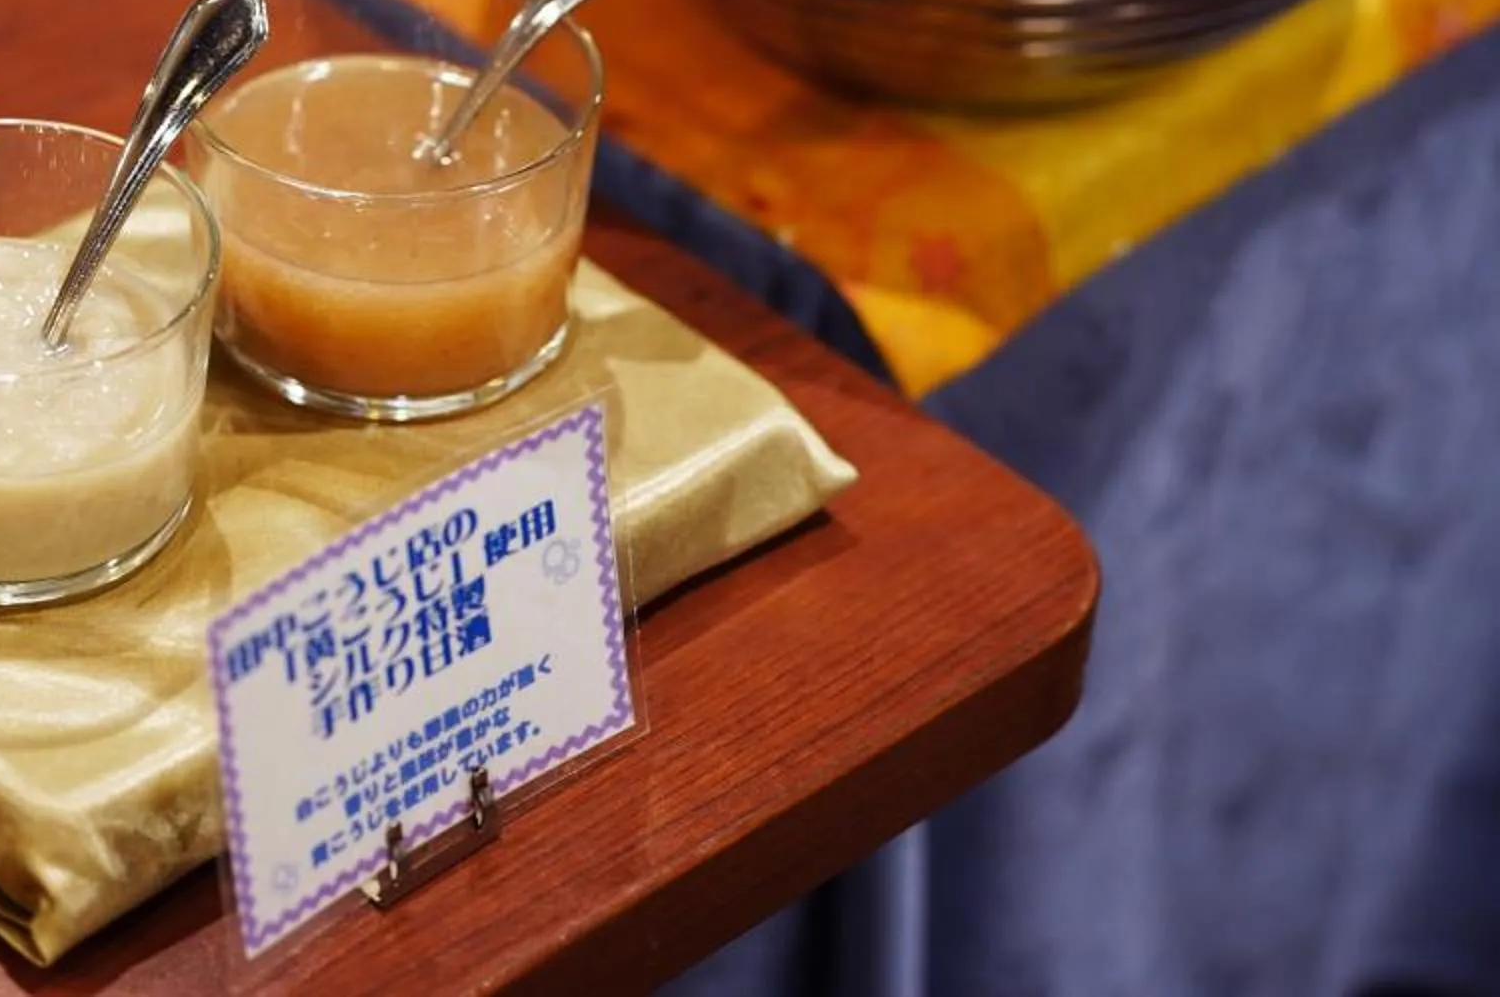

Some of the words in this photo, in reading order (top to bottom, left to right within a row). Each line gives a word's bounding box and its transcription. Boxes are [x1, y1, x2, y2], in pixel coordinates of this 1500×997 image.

[310, 574, 486, 705] シルク特製
[316, 615, 492, 738] 手作り甘酒
